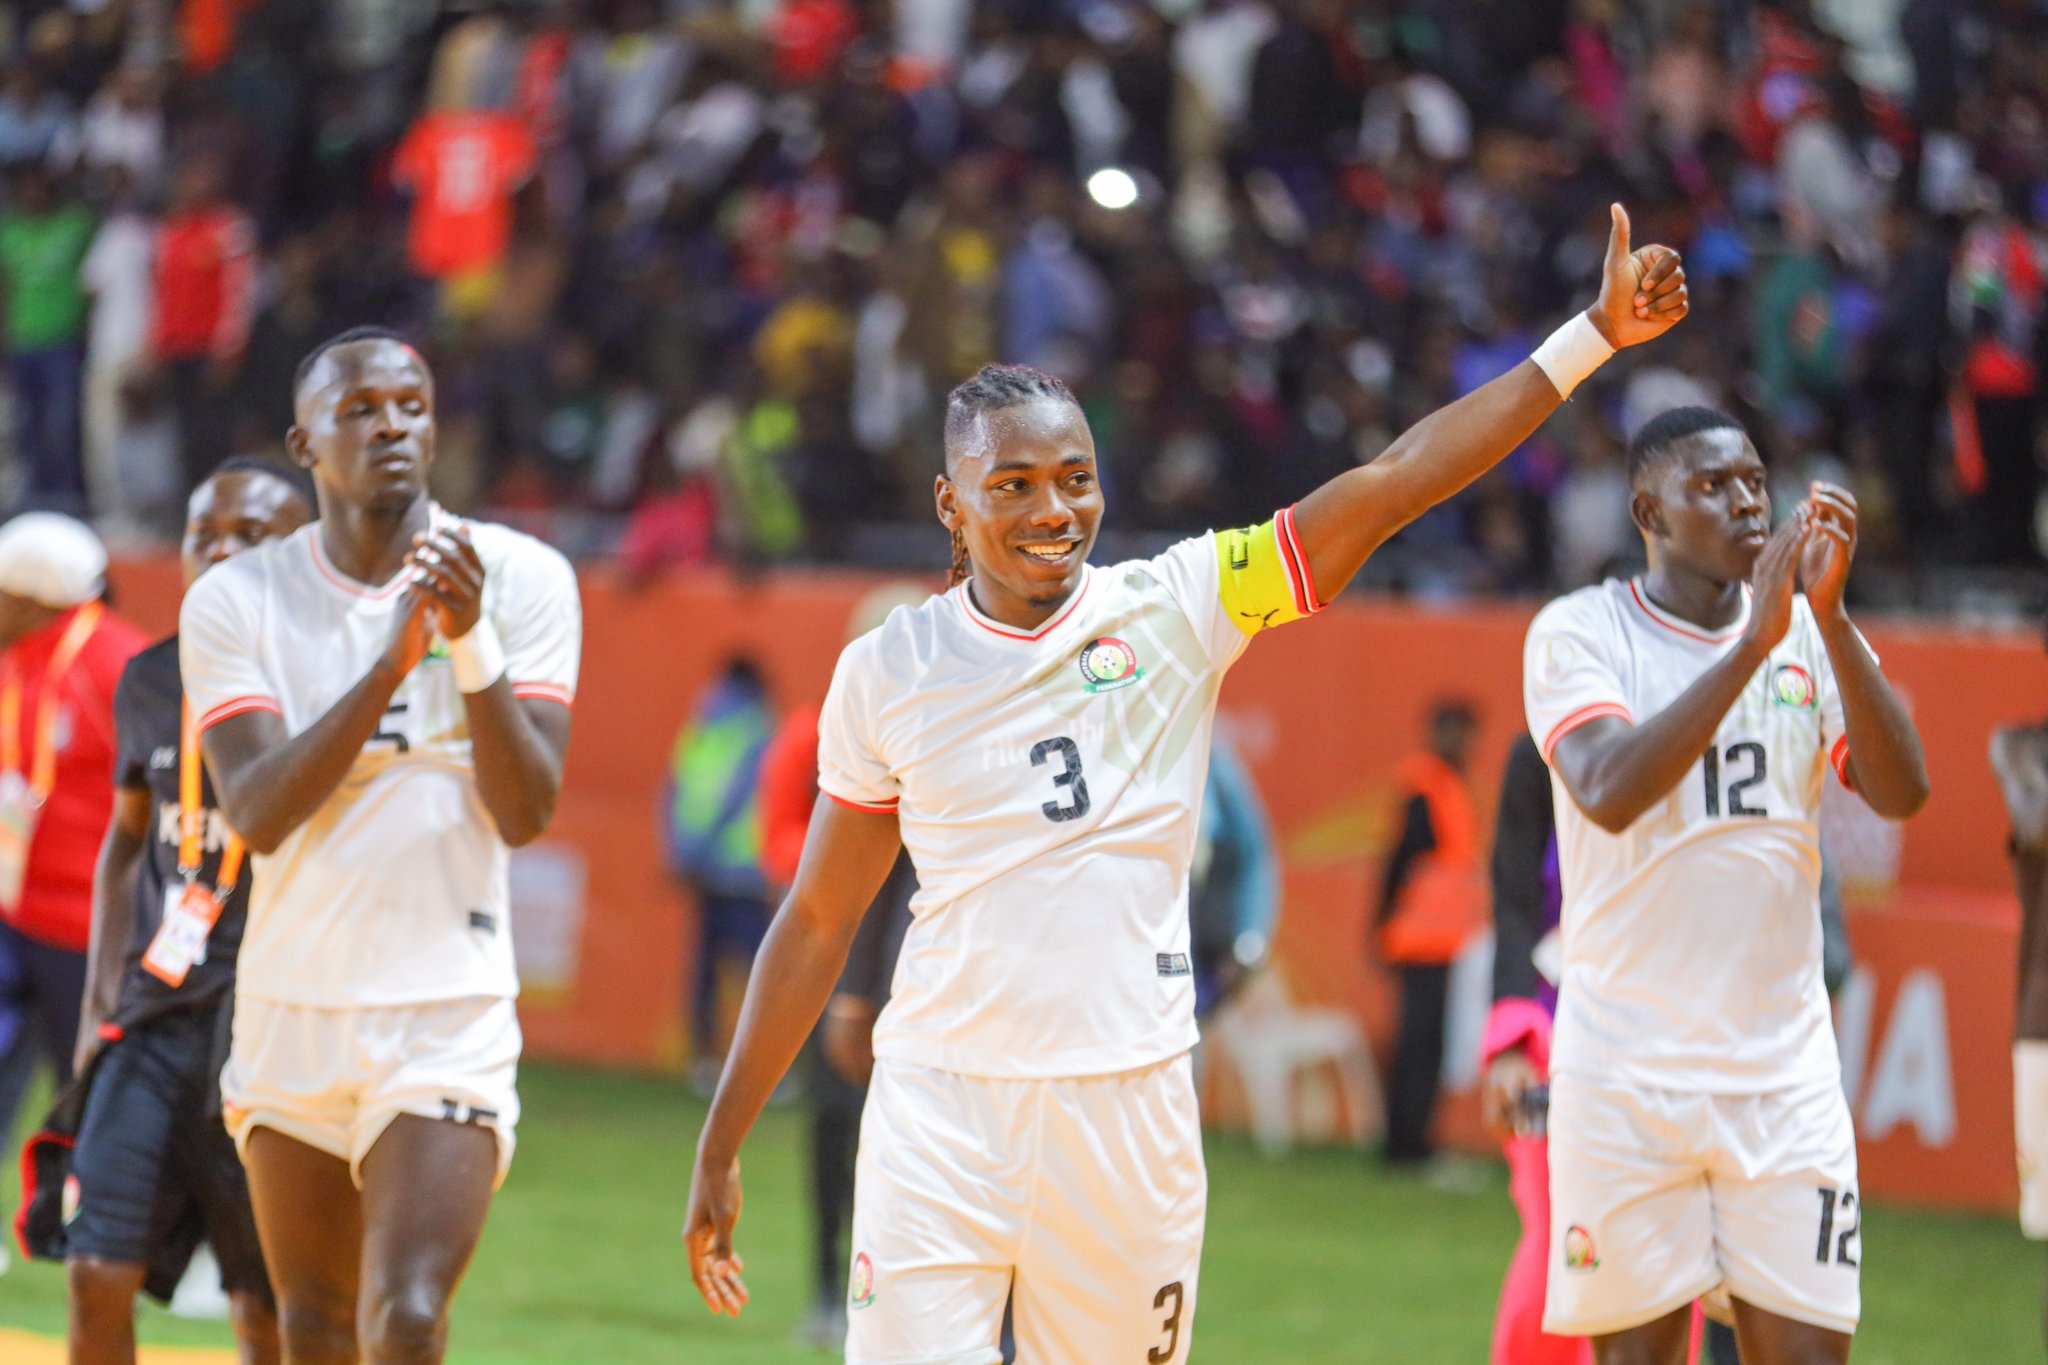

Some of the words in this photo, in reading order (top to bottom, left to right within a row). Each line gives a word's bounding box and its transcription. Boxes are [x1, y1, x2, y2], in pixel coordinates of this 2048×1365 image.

[1081, 651, 1098, 682] FOOTBALL
[1095, 674, 1137, 692] FEDERATION
[1030, 736, 1090, 822] 3
[1704, 742, 1767, 817] 12
[1816, 1187, 1858, 1267] 12
[1147, 1281, 1183, 1365] 3
